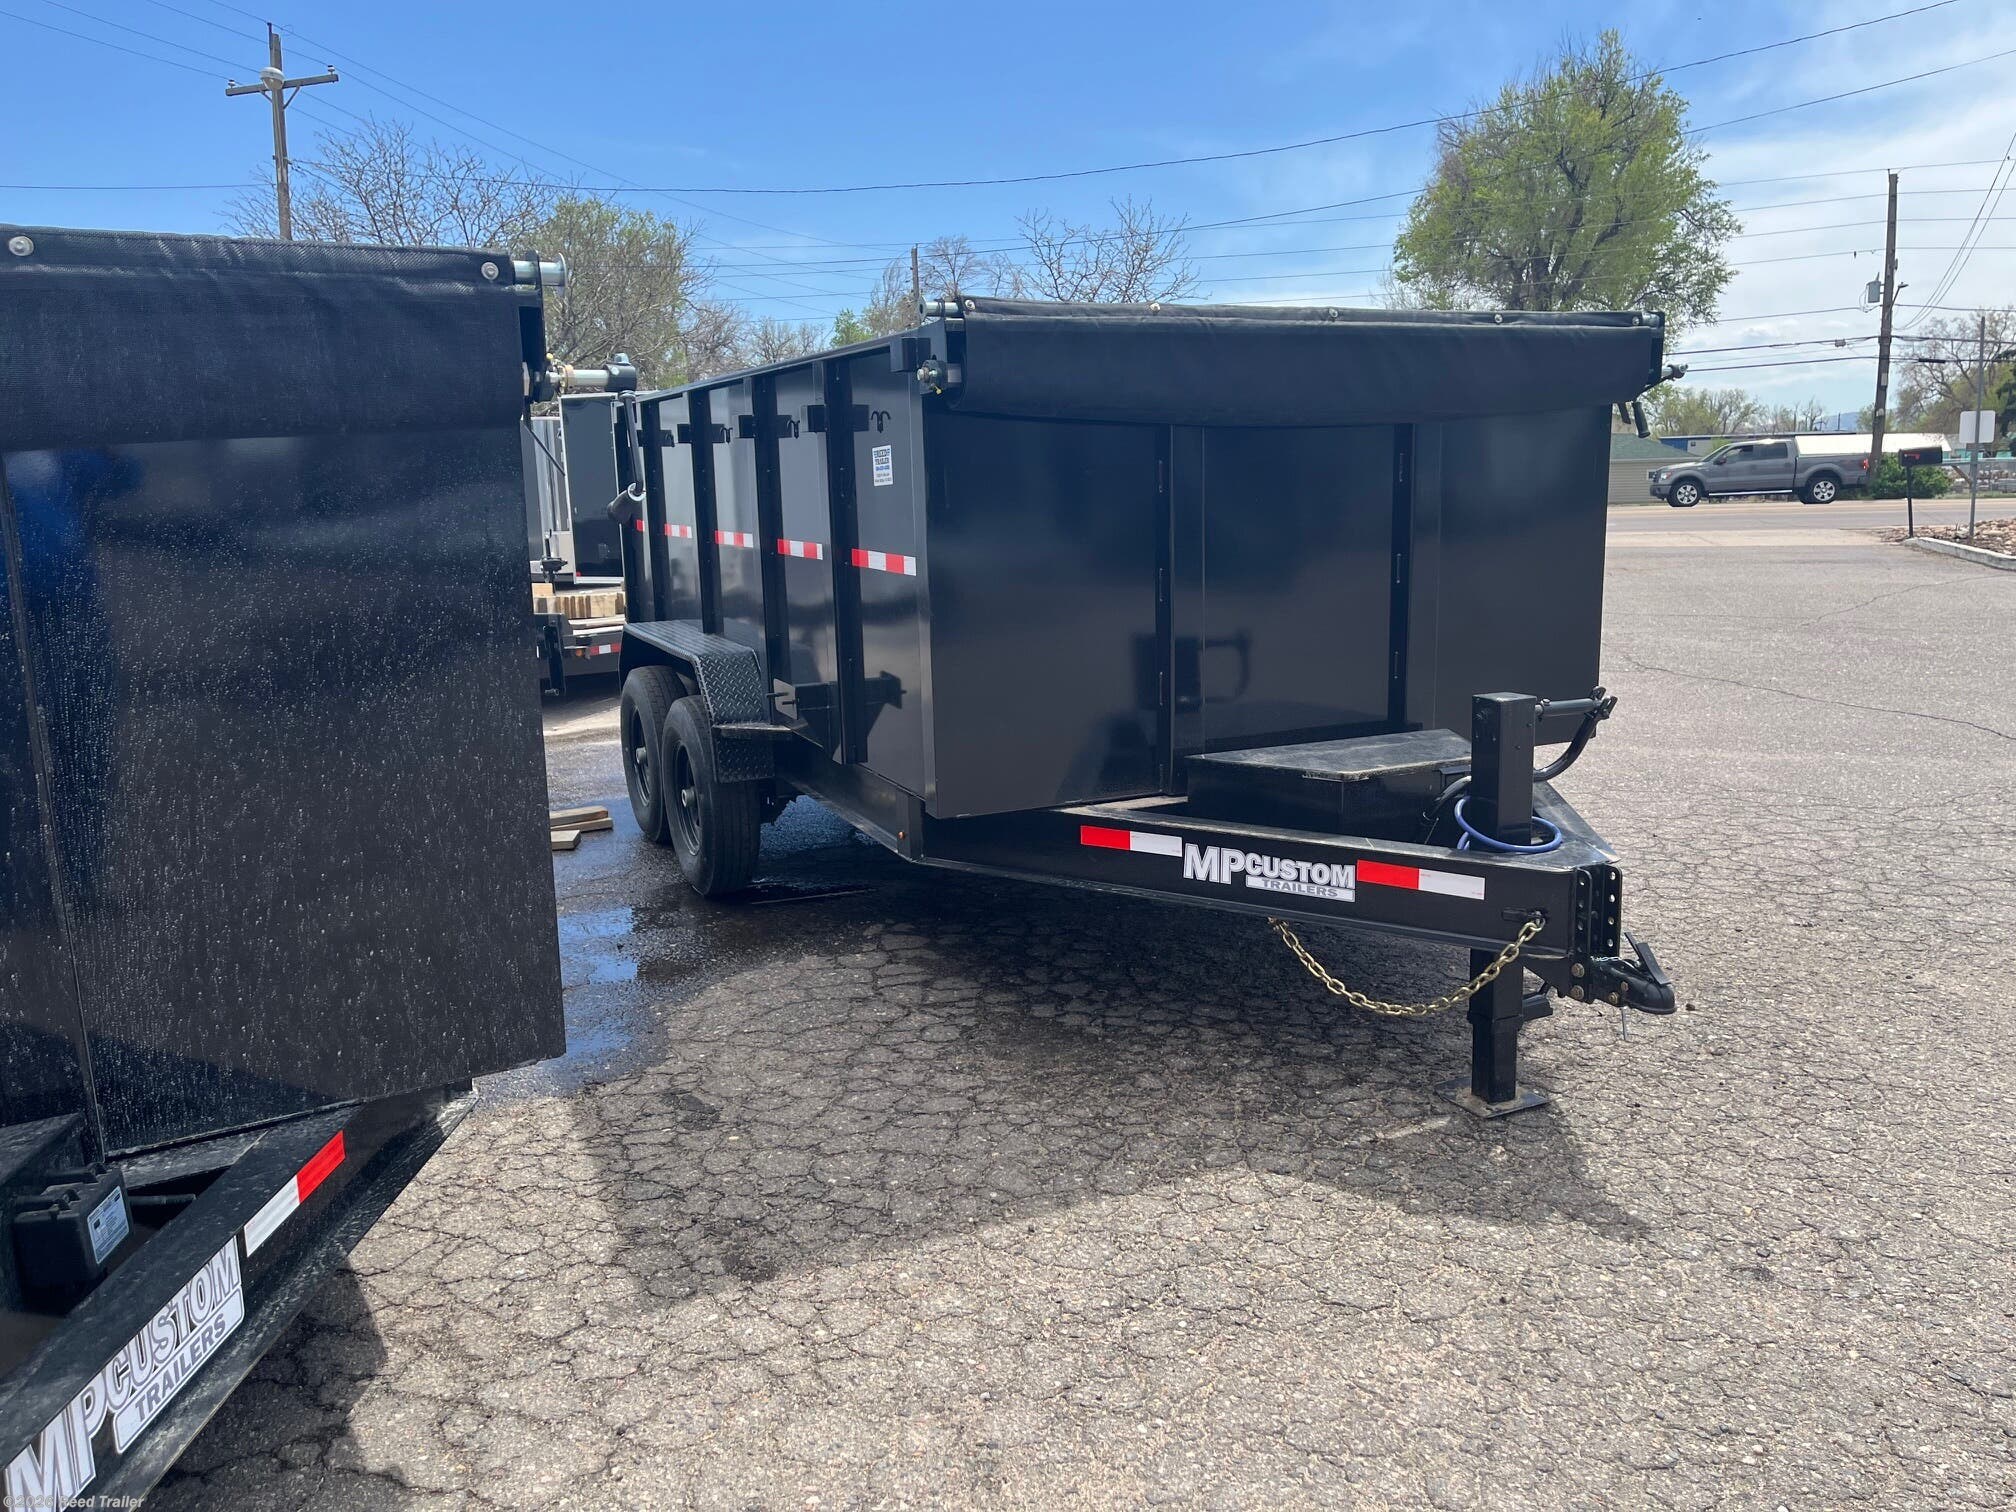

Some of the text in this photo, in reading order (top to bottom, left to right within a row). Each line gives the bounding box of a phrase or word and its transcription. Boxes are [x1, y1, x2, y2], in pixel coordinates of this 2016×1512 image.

[1183, 842, 1356, 890] MP CUSTOM
[1261, 878, 1338, 898] TRAILERS
[104, 1235, 241, 1411] CUSTOM
[135, 1312, 226, 1423] TRAILERS
